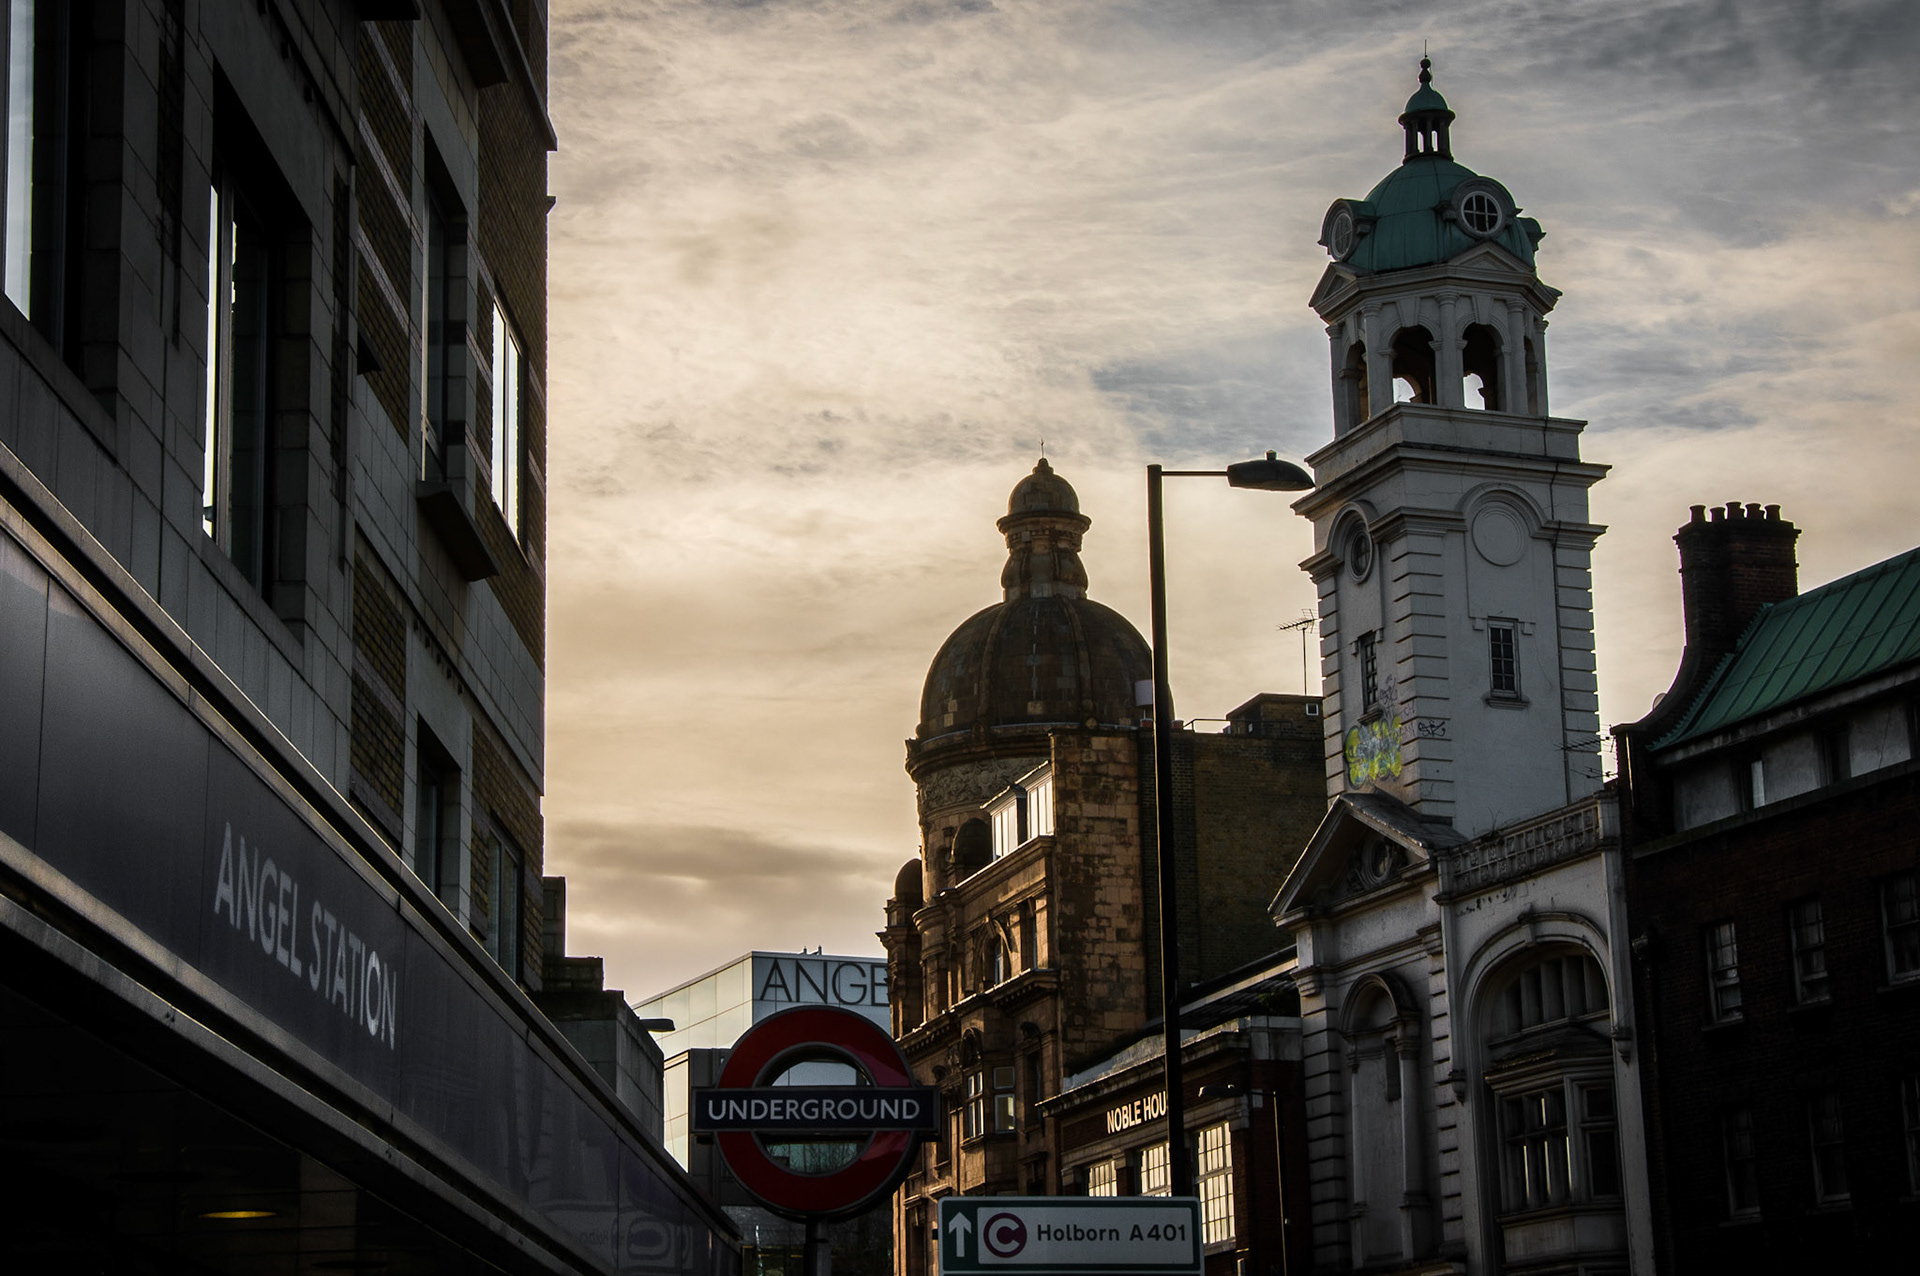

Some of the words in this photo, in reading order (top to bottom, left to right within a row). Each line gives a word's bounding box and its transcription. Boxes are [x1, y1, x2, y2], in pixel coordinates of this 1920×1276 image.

[214, 822, 302, 977] ANGEL
[309, 900, 397, 1051] STATION
[760, 958, 890, 1006] ANGE
[708, 1098, 920, 1121] UNDERGROUND
[1106, 1100, 1142, 1135] NOBLE
[1143, 1090, 1167, 1121] HOU
[1037, 1225, 1120, 1241] Holborn
[1129, 1224, 1187, 1242] A401
